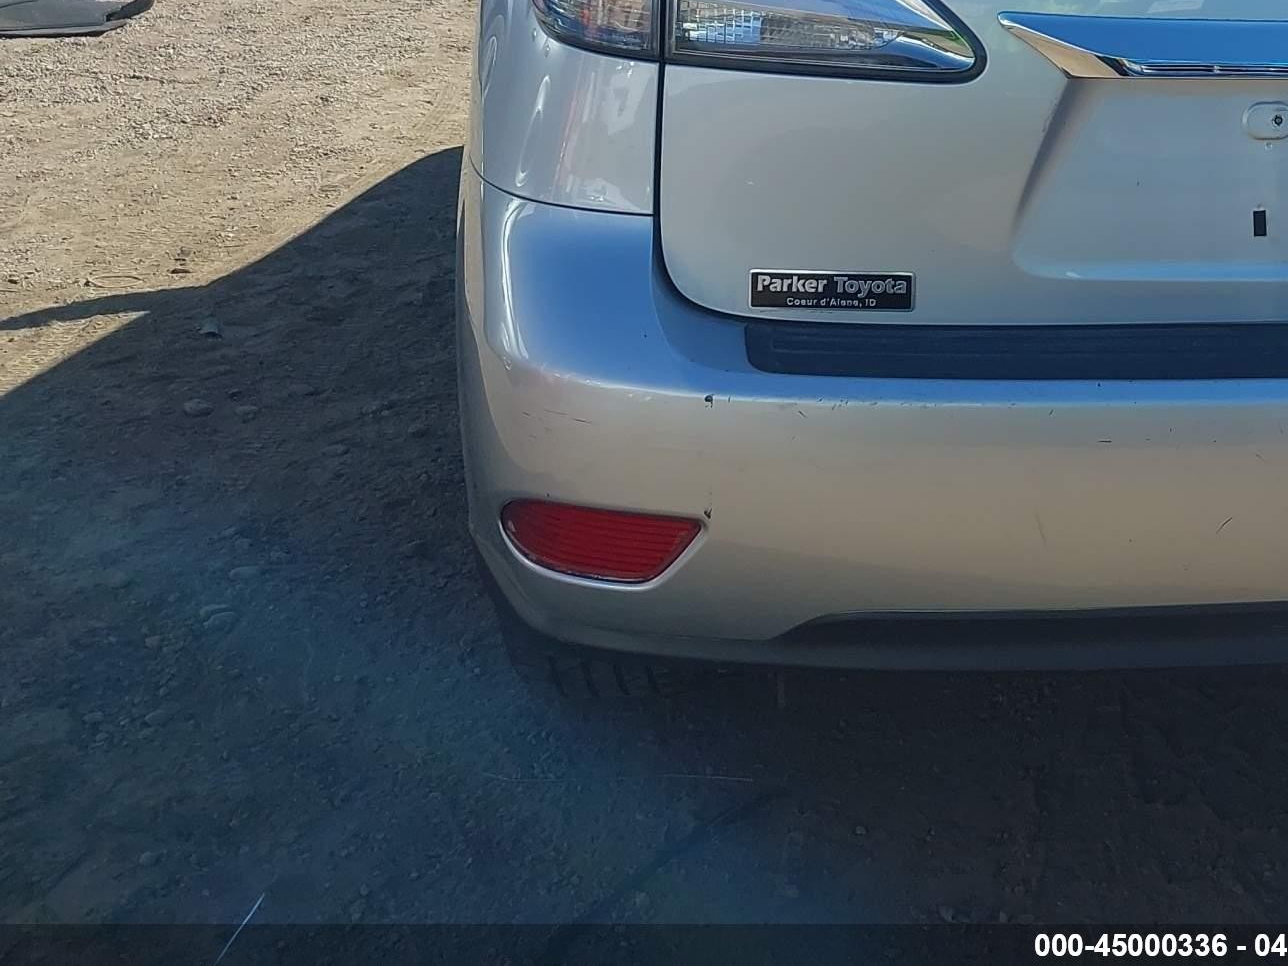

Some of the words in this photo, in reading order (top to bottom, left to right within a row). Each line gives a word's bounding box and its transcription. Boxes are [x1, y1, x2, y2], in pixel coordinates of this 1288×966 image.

[756, 274, 828, 293] Parker
[833, 276, 907, 298] Toyota
[786, 297, 818, 306] Coeur
[865, 298, 877, 307] ID
